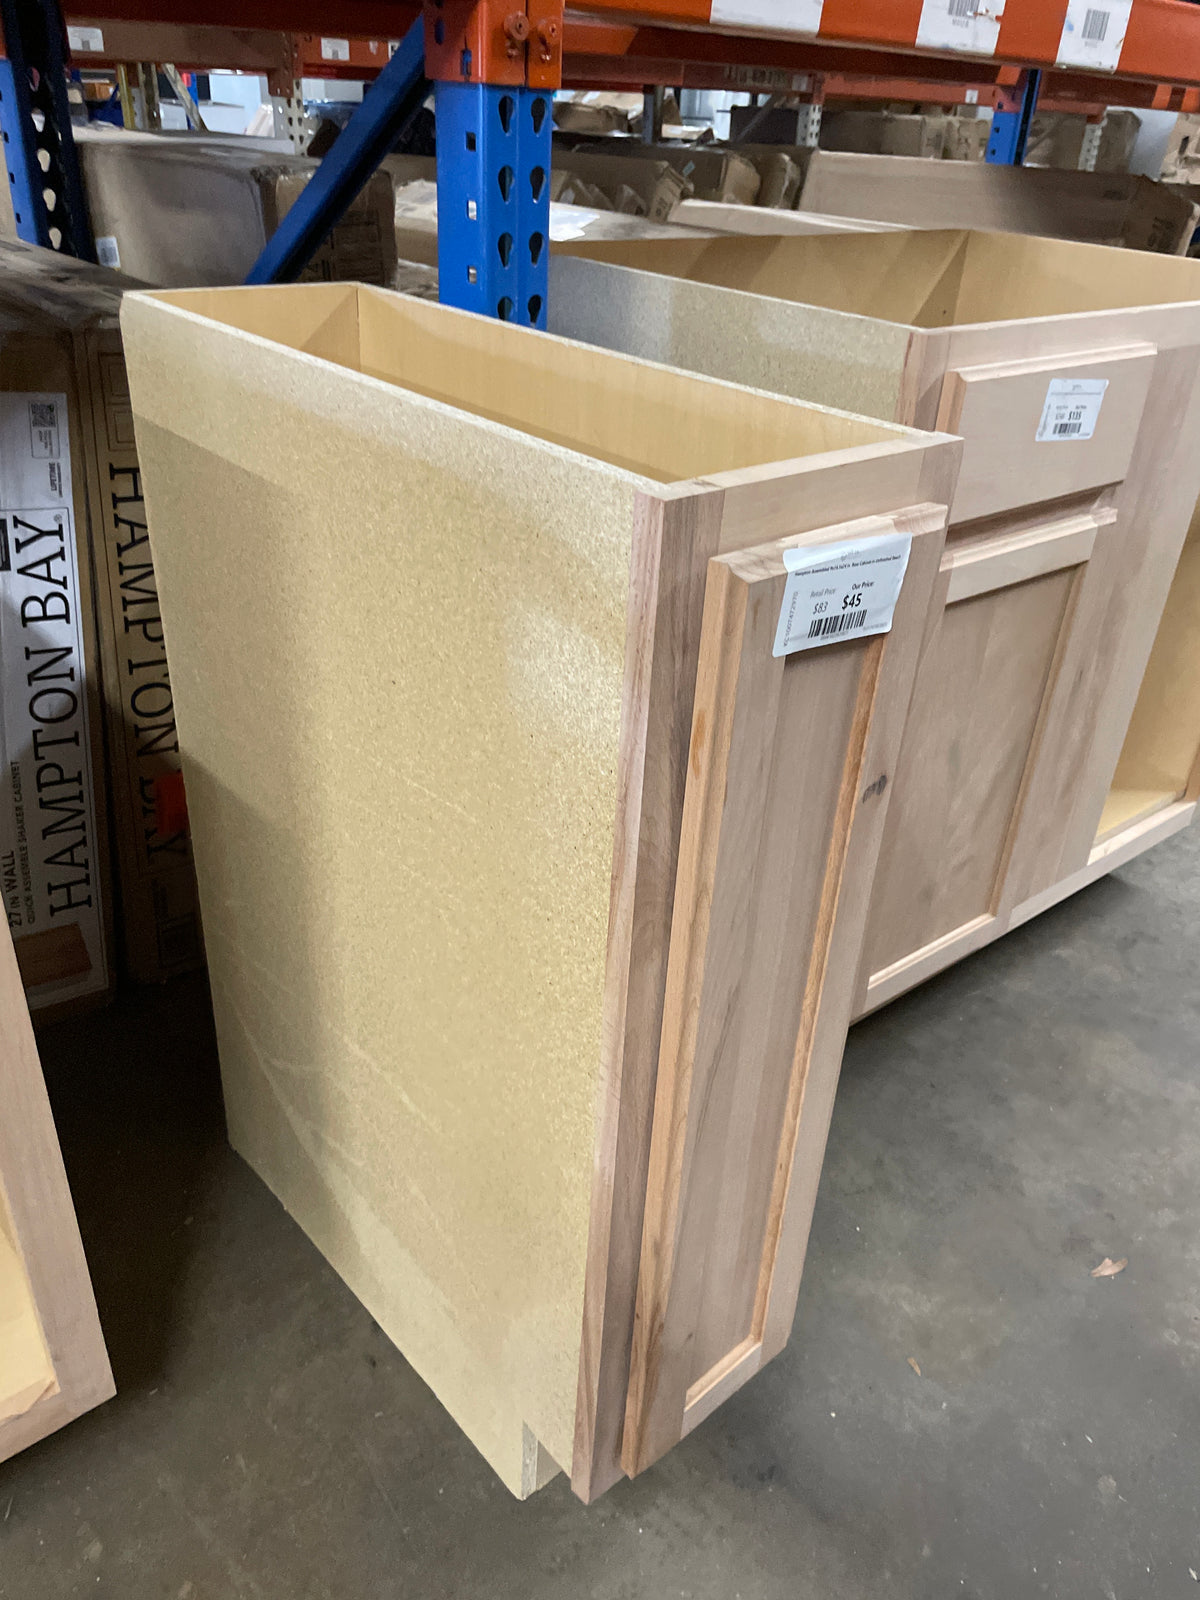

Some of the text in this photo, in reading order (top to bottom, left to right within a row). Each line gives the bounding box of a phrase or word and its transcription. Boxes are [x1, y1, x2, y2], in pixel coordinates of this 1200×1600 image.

[810, 588, 825, 599] Retail
[813, 601, 828, 614] $83
[842, 593, 862, 610] $45
[13, 514, 92, 917] HAMPTON BAY
[10, 761, 23, 802] CABINET
[15, 804, 28, 844] SHAKER
[2, 851, 18, 892] WALL
[8, 911, 22, 928] 27
